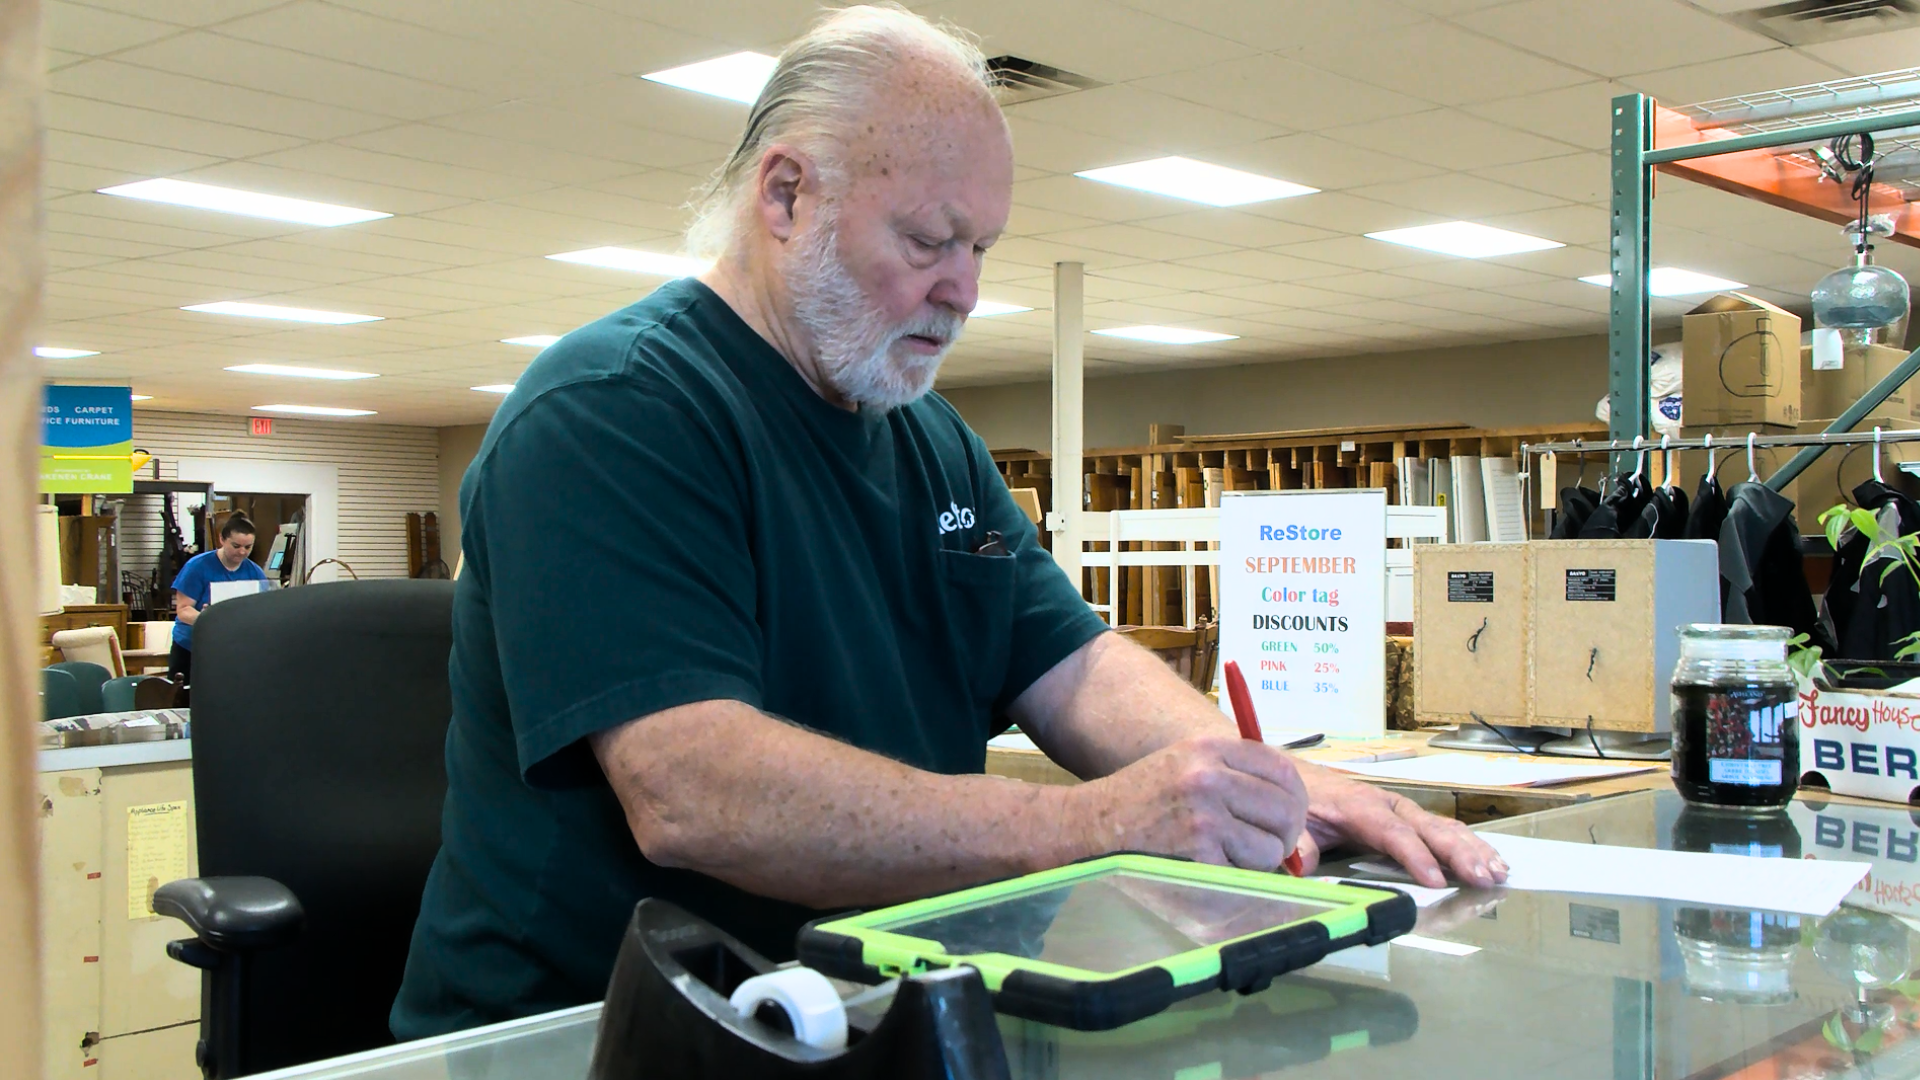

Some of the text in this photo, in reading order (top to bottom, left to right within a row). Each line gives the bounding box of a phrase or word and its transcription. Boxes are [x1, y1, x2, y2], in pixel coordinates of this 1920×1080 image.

[74, 406, 114, 414] CARPET
[65, 417, 120, 426] FURNITURE
[252, 418, 272, 435] EXIT
[80, 473, 112, 481] CRANE
[1260, 524, 1342, 541] ReStore
[1245, 556, 1356, 574] SEPTEMBER
[1261, 586, 1339, 608] Color tag
[1252, 614, 1349, 632] DISCOUNTS
[1261, 640, 1339, 654] GREEN 50%
[1260, 660, 1340, 674] PINK 25%
[1261, 679, 1339, 694] BLUE 35%
[1799, 689, 1870, 732] Fancy
[1813, 738, 1918, 780] BER
